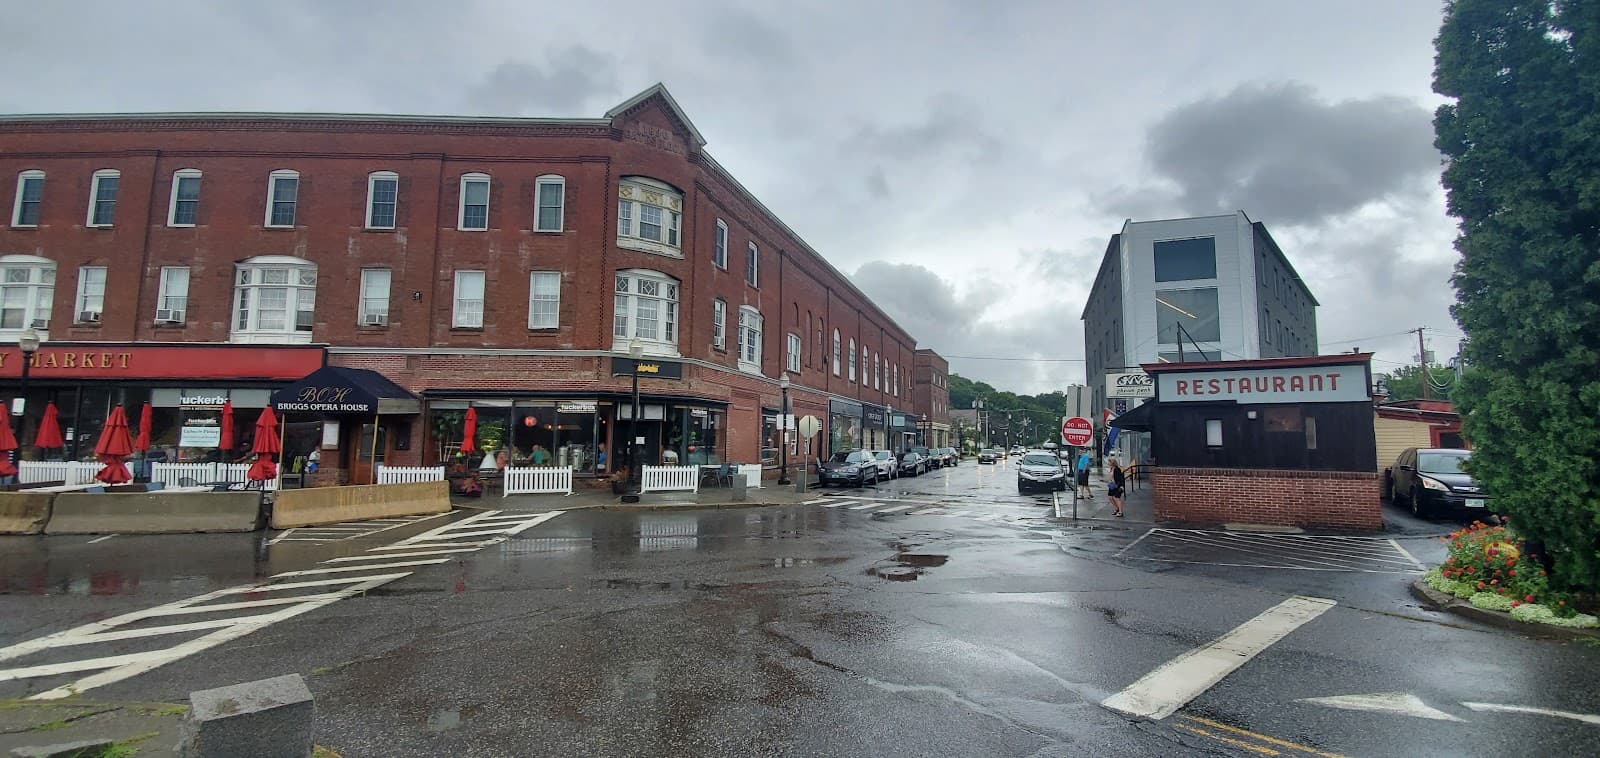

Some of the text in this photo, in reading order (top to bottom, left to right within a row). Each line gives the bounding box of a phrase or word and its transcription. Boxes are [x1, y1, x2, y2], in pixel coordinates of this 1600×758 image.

[1176, 372, 1341, 396] RESTAURANT
[297, 386, 352, 403] BOH
[277, 402, 369, 412] BRIGGS OPERA HOUSE
